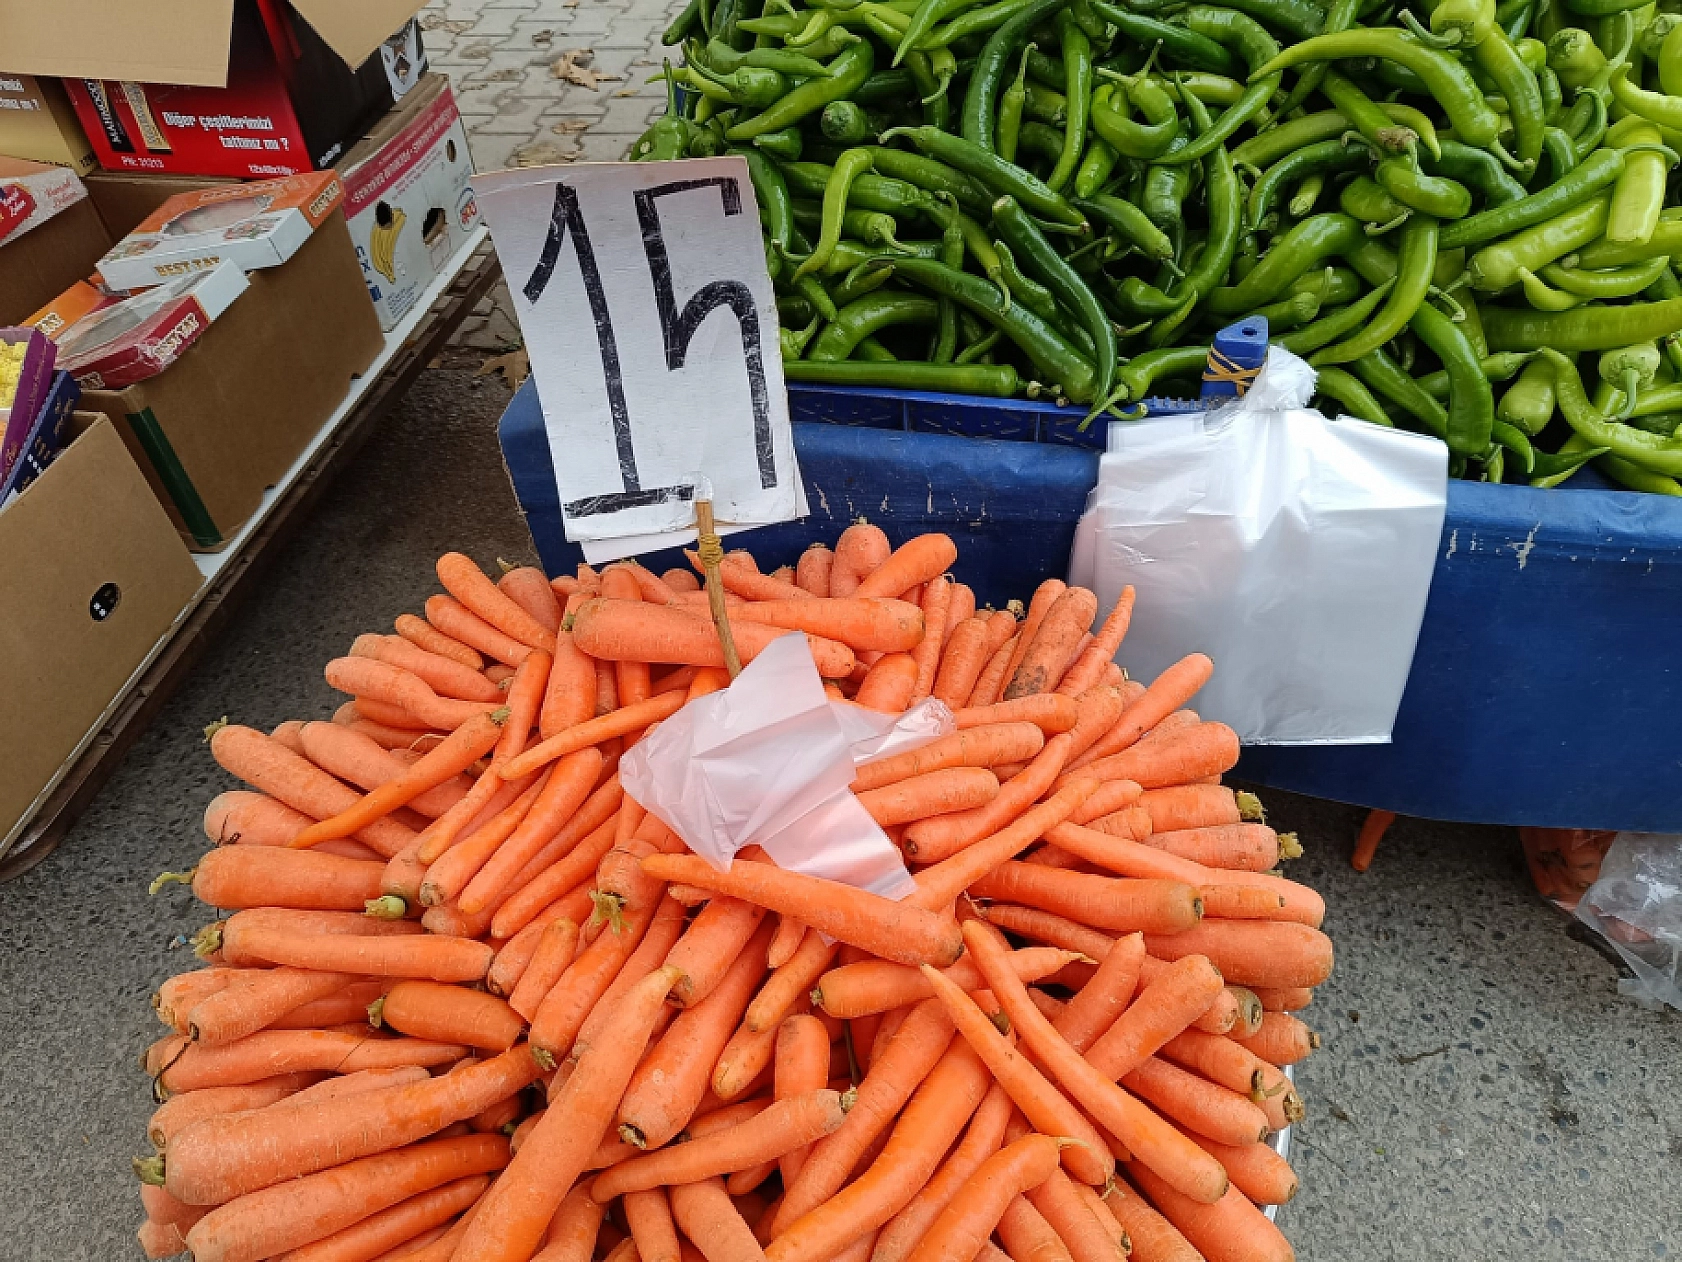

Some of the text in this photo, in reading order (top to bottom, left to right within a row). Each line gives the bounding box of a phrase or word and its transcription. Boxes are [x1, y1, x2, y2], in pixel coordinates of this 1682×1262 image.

[162, 111, 274, 132] Diğer çeşitlerimizi
[280, 137, 290, 151] ?
[154, 260, 191, 277] BEST
[522, 177, 777, 518] 15
